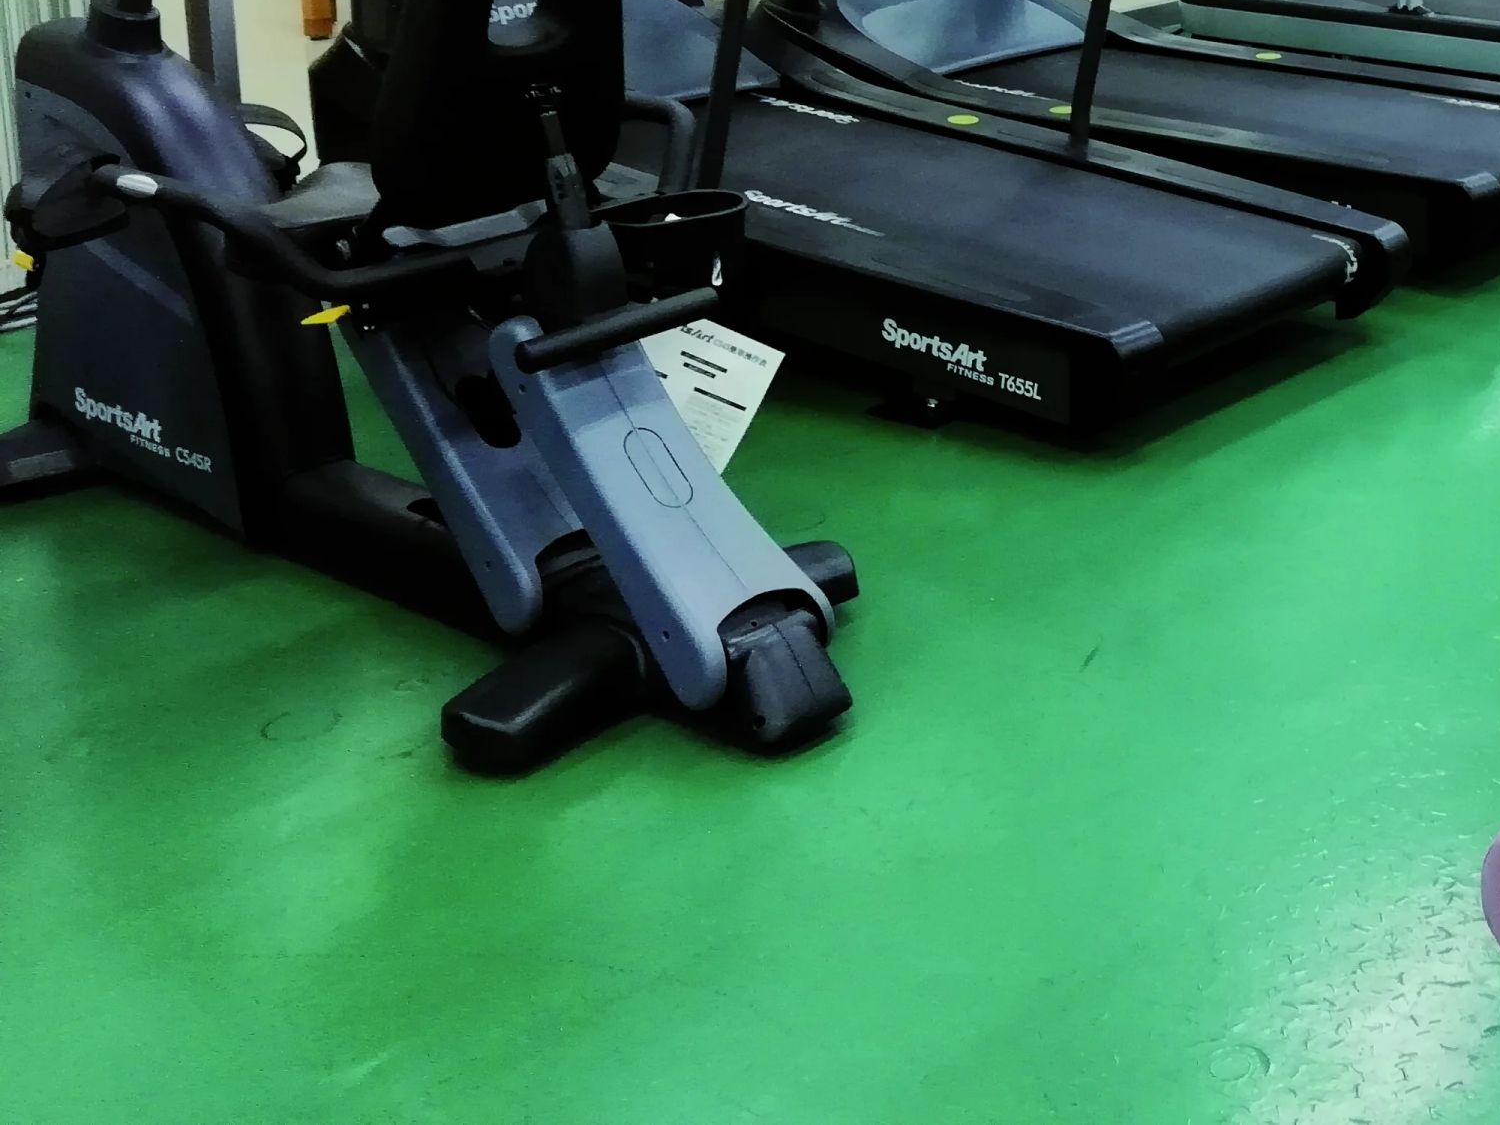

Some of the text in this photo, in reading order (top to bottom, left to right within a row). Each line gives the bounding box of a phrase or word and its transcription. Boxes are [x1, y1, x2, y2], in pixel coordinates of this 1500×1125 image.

[881, 318, 987, 372] SportsArt
[946, 362, 1042, 401] FITNESS T655L
[75, 386, 162, 443] SportsArt
[130, 434, 171, 458] FITNESS
